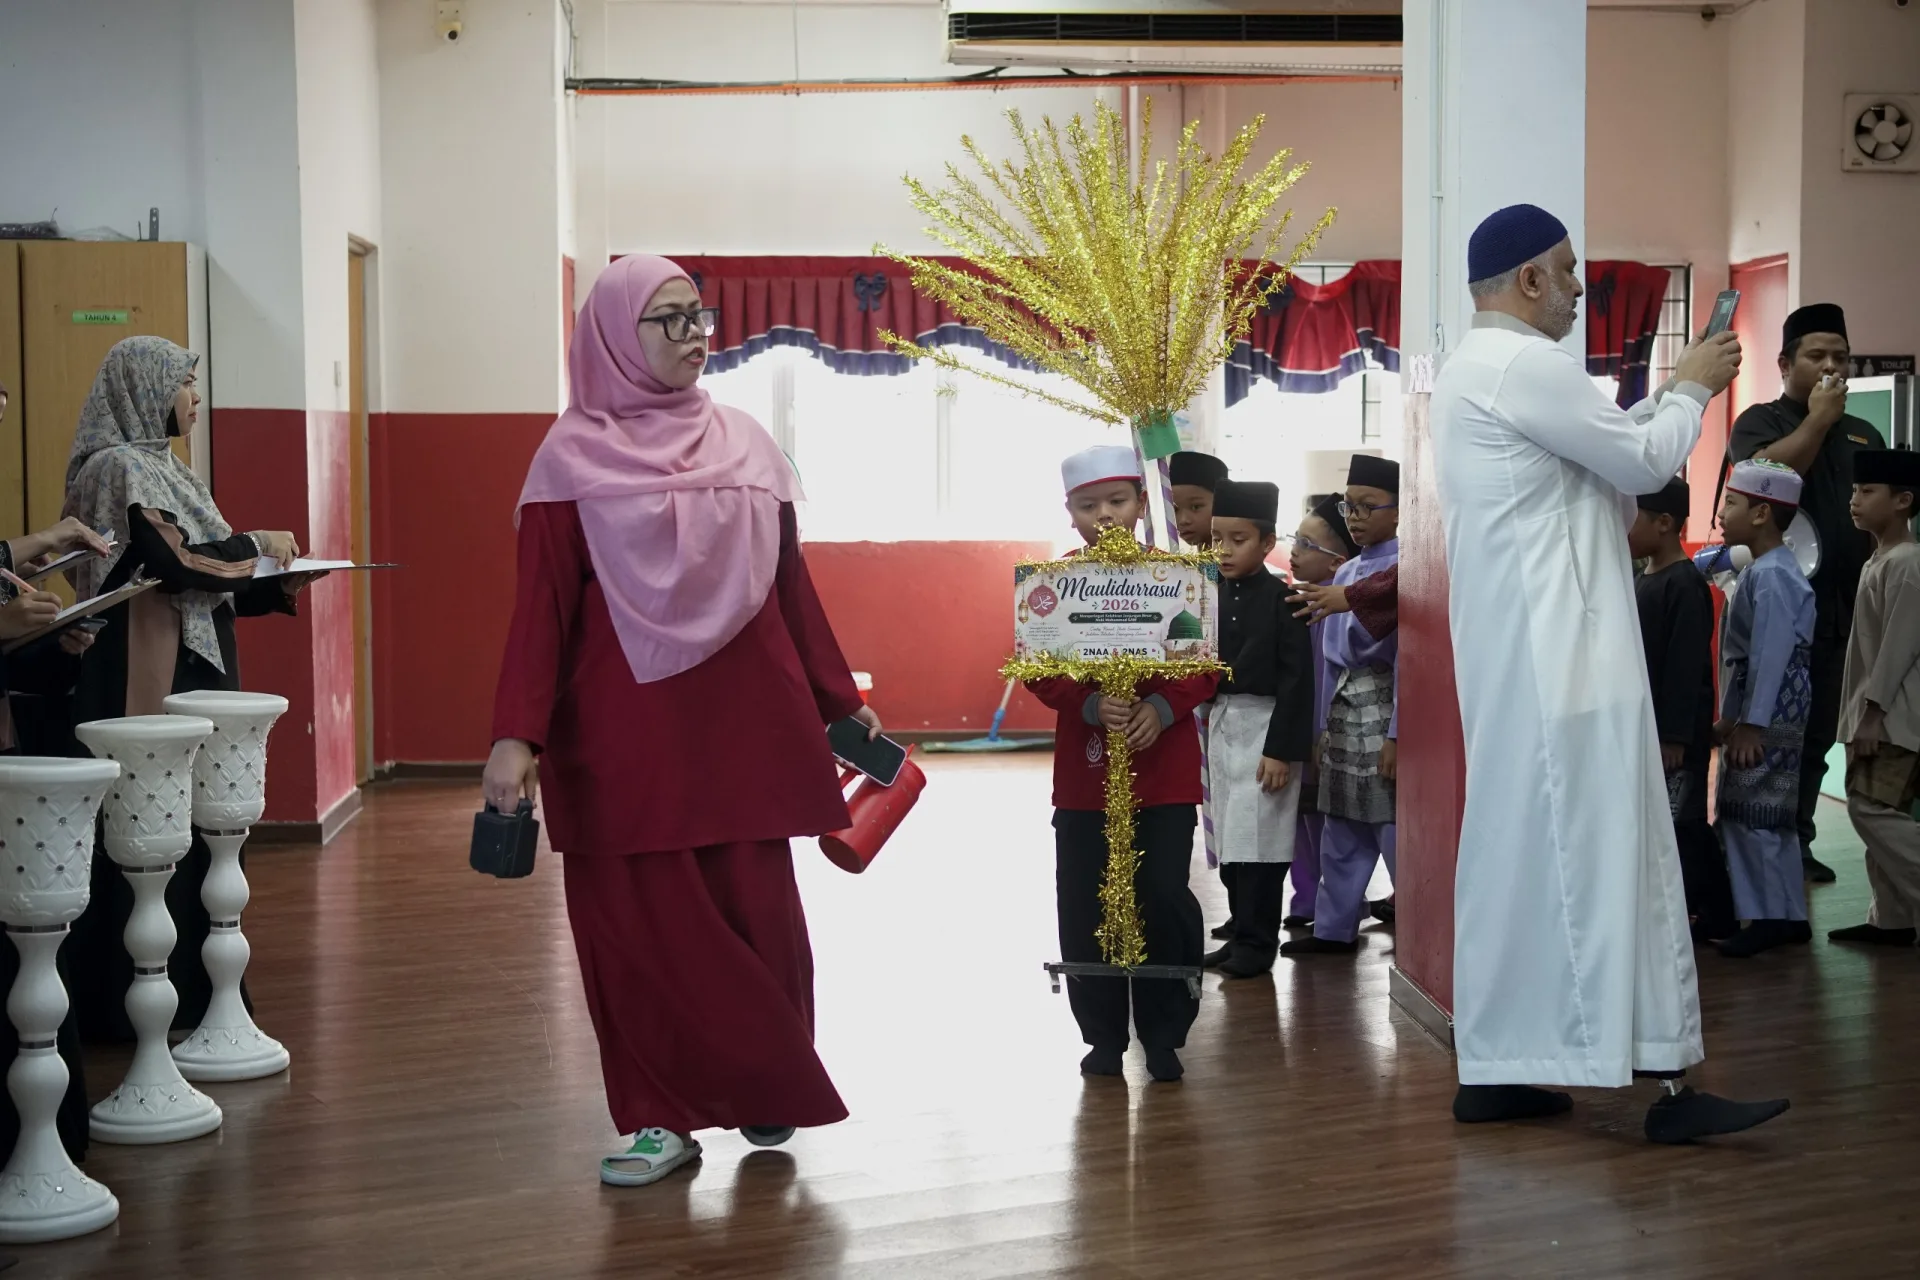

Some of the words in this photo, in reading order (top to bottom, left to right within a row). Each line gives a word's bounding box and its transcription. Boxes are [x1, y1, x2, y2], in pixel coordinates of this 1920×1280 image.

[1881, 360, 1911, 369] TOILET
[1094, 568, 1135, 576] SALAM
[1057, 576, 1182, 602] Maulidurrasul
[1101, 599, 1140, 611] 2026
[1083, 647, 1109, 656] 2NAA
[1122, 647, 1148, 656] 2NAS
